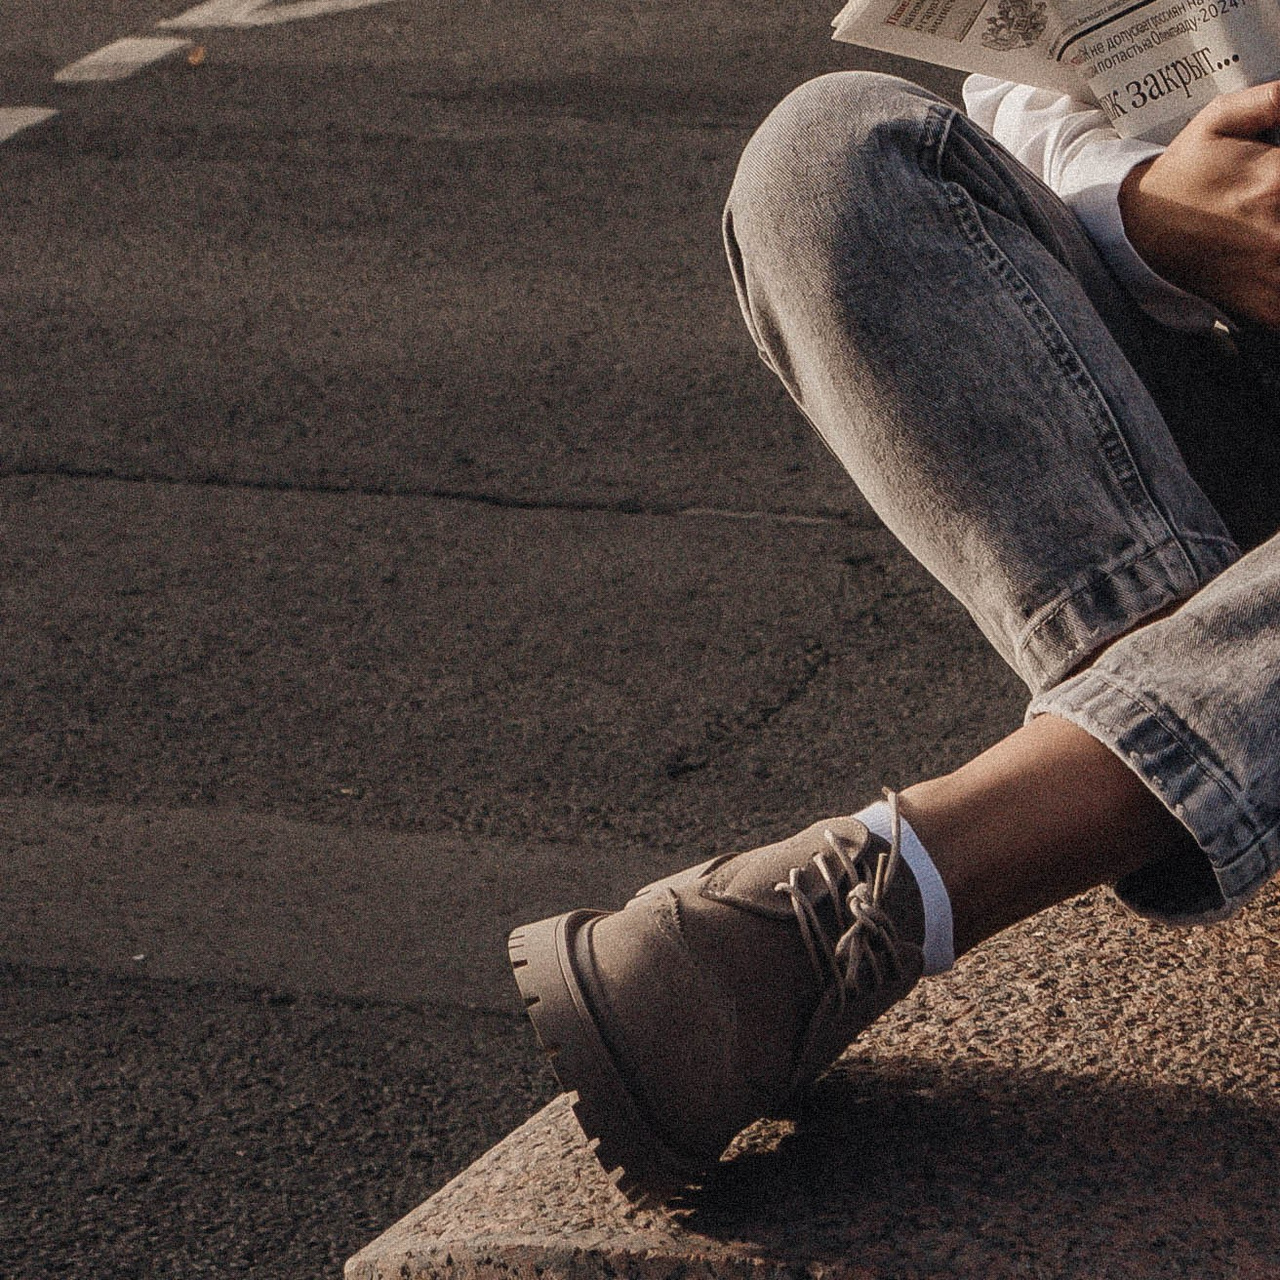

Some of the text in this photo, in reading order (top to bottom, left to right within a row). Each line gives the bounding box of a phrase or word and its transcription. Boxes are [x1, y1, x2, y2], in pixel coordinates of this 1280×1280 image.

[1091, 42, 1105, 57] не
[1098, 44, 1144, 73] попасть
[1126, 46, 1240, 109] закрыт...
